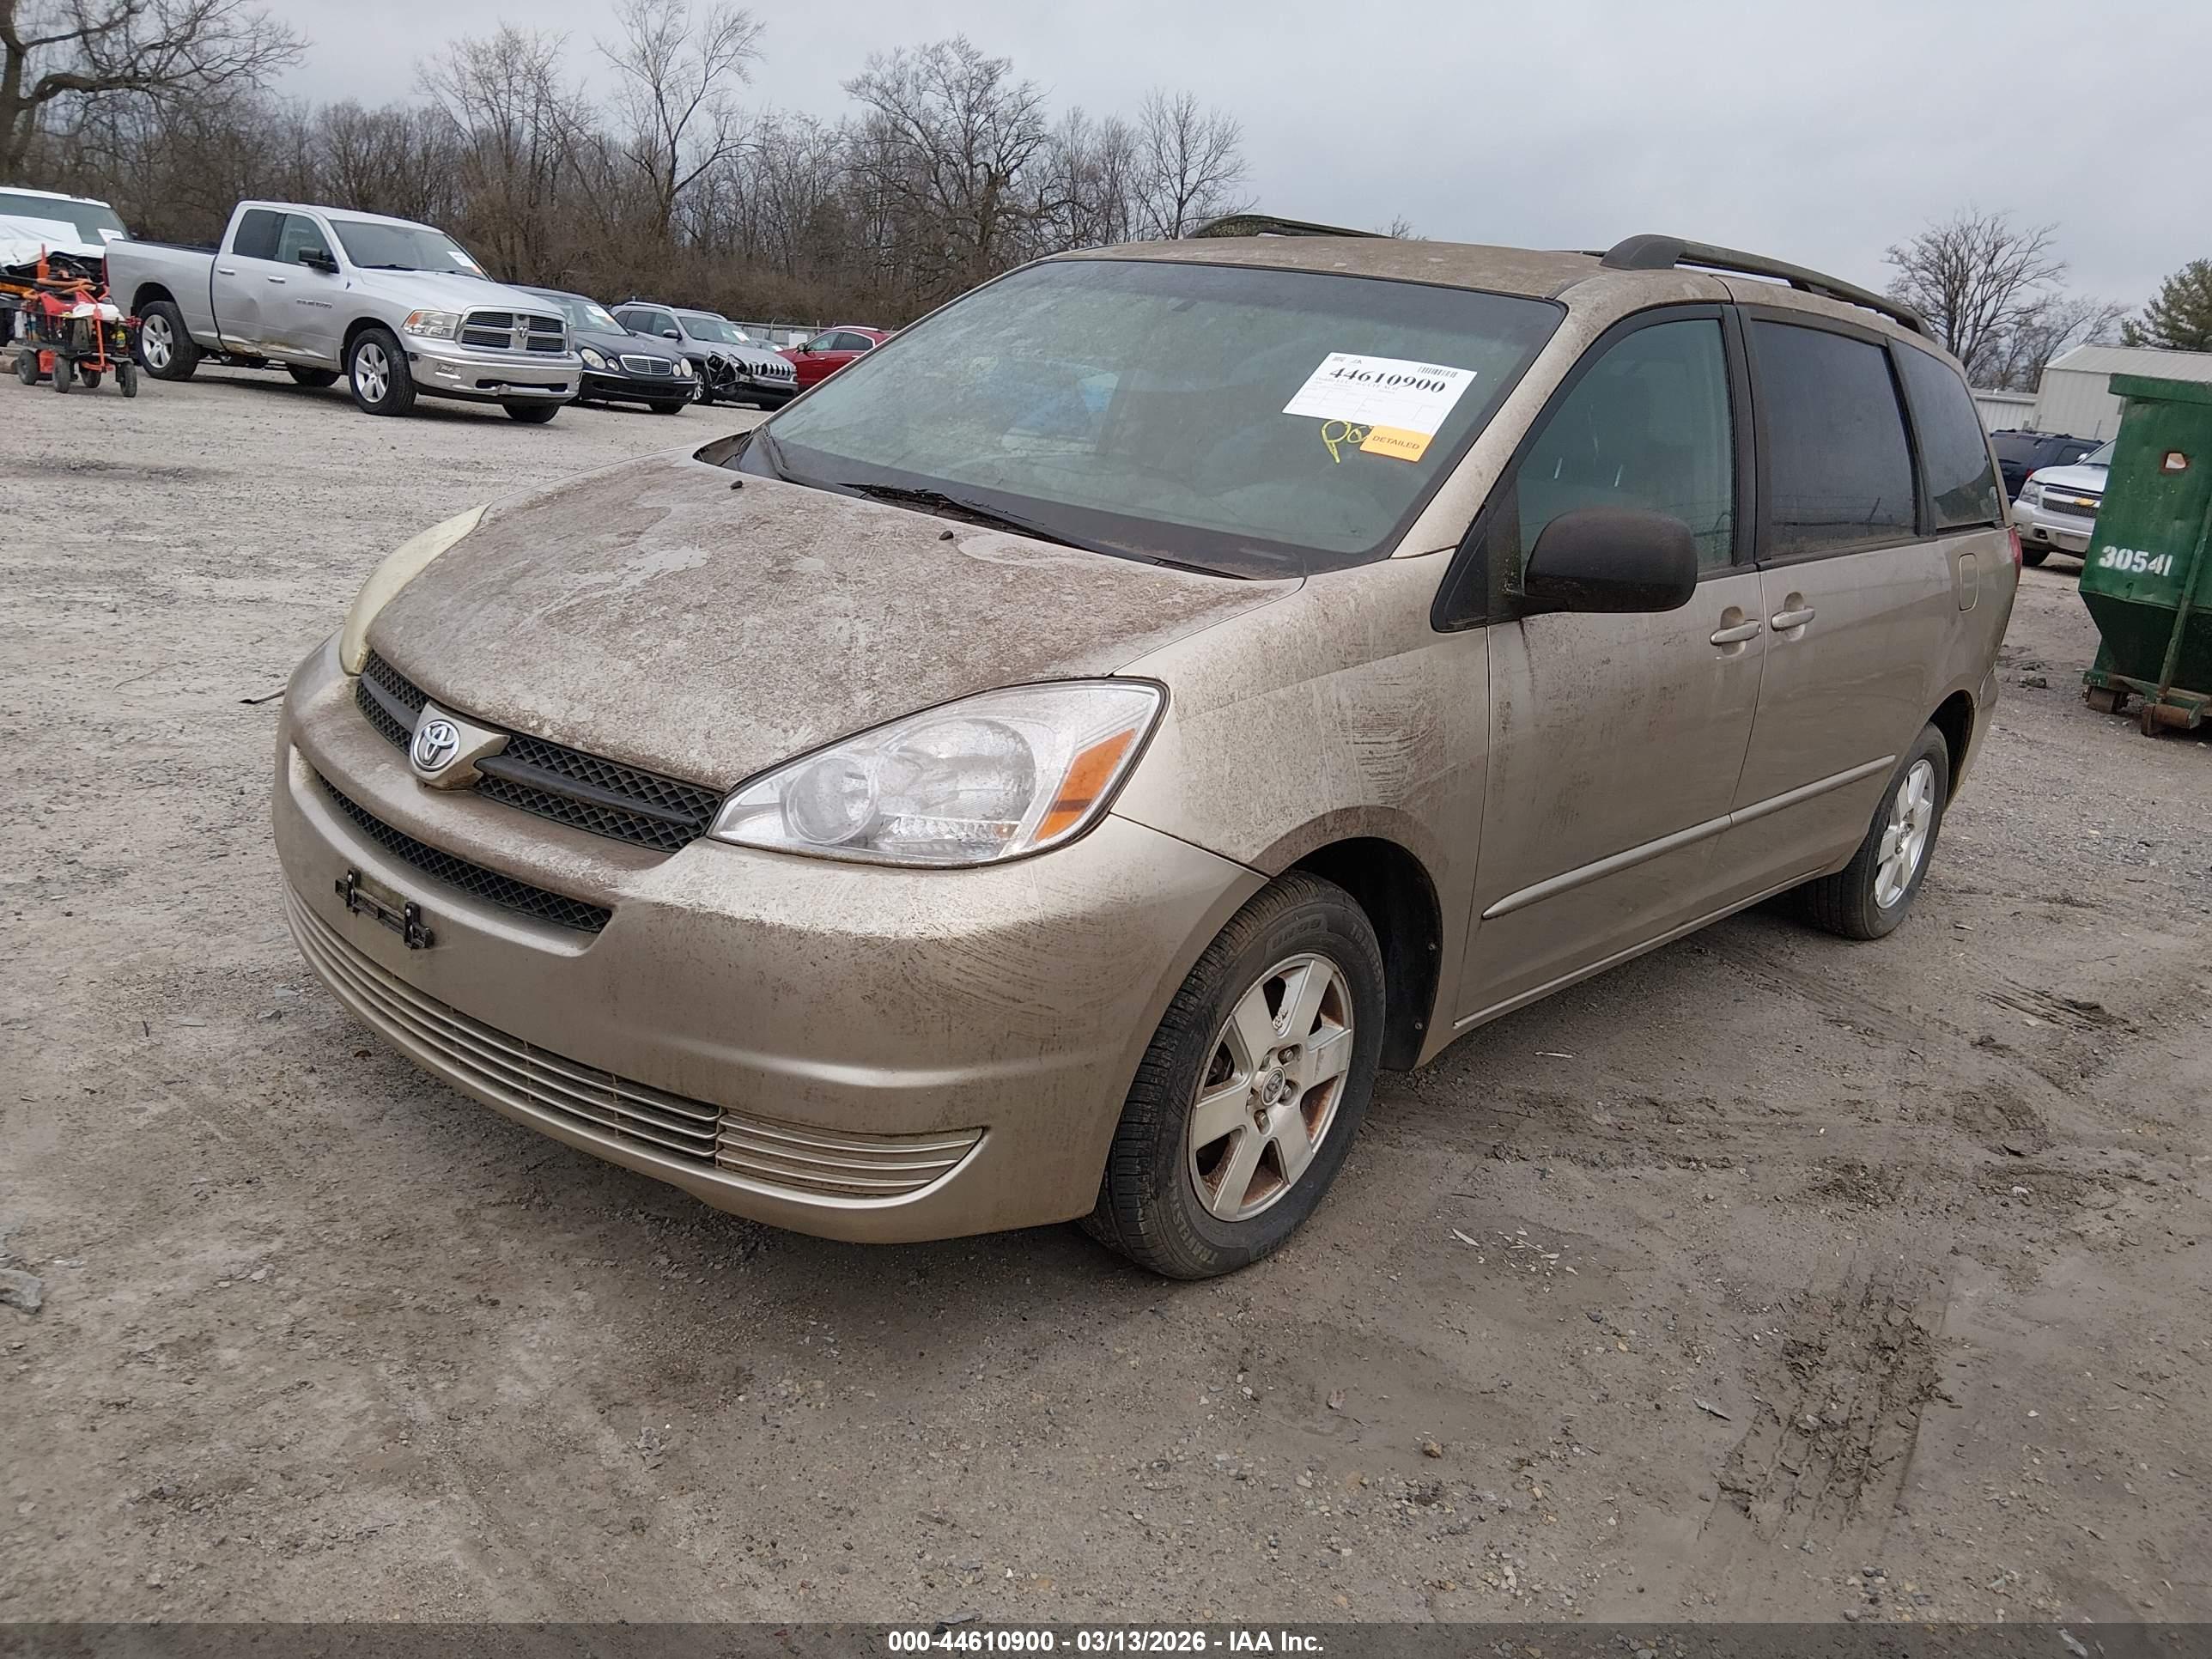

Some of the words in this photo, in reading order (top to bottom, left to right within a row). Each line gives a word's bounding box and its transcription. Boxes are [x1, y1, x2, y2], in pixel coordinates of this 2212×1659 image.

[1329, 367, 1446, 393] 44610900
[1372, 435, 1420, 450] DETAILED
[2099, 545, 2173, 576] 30541
